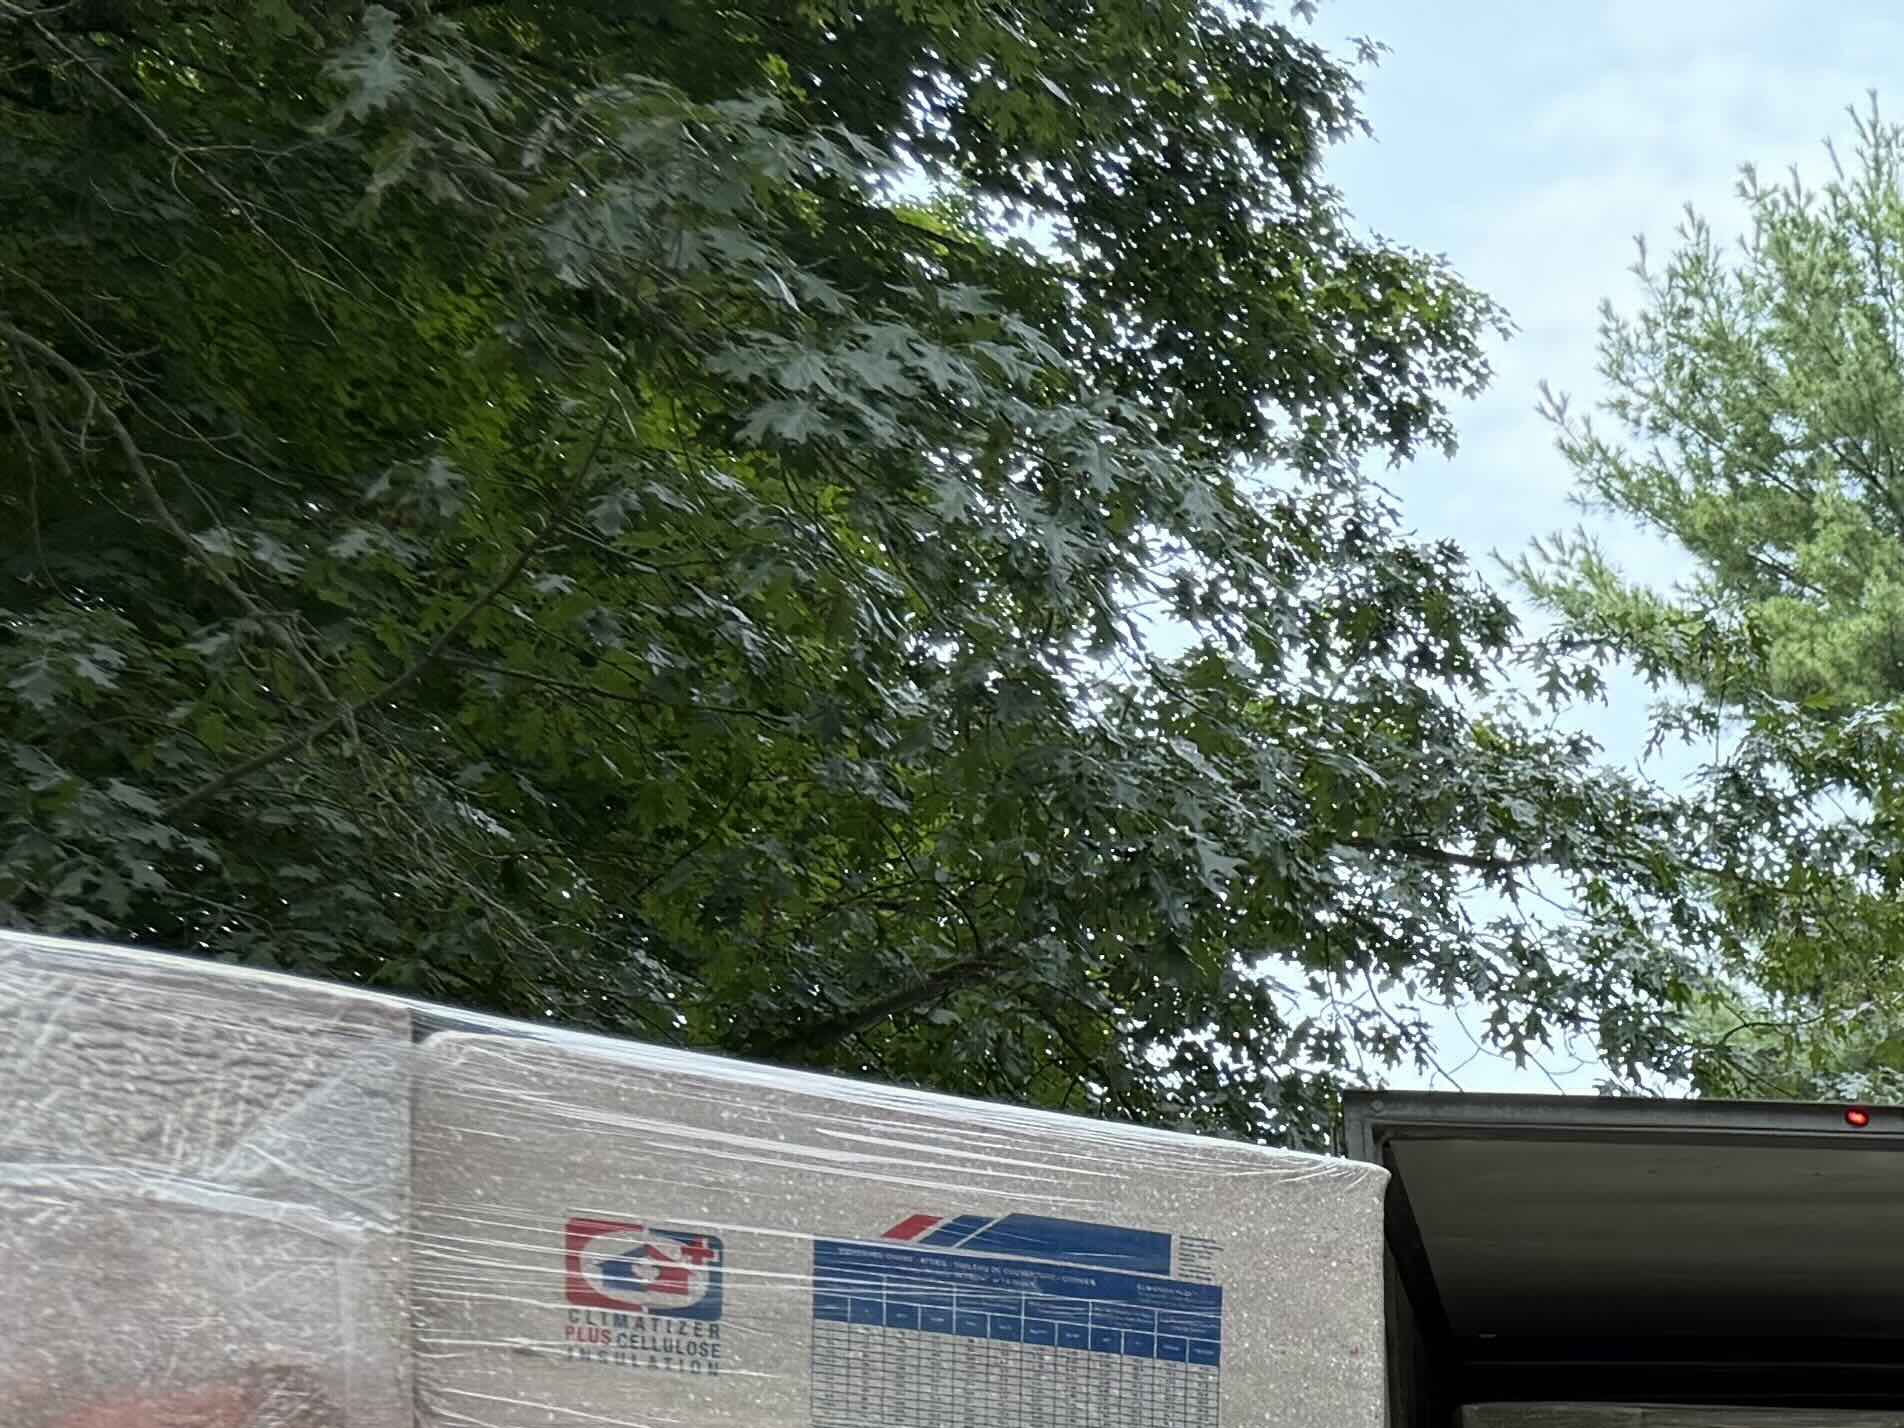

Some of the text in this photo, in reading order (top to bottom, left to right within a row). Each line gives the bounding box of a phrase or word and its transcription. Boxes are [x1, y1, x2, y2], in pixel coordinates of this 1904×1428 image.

[567, 1309, 721, 1338] CLIMATIZER
[564, 1325, 721, 1359] PLUS CELLULOSE
